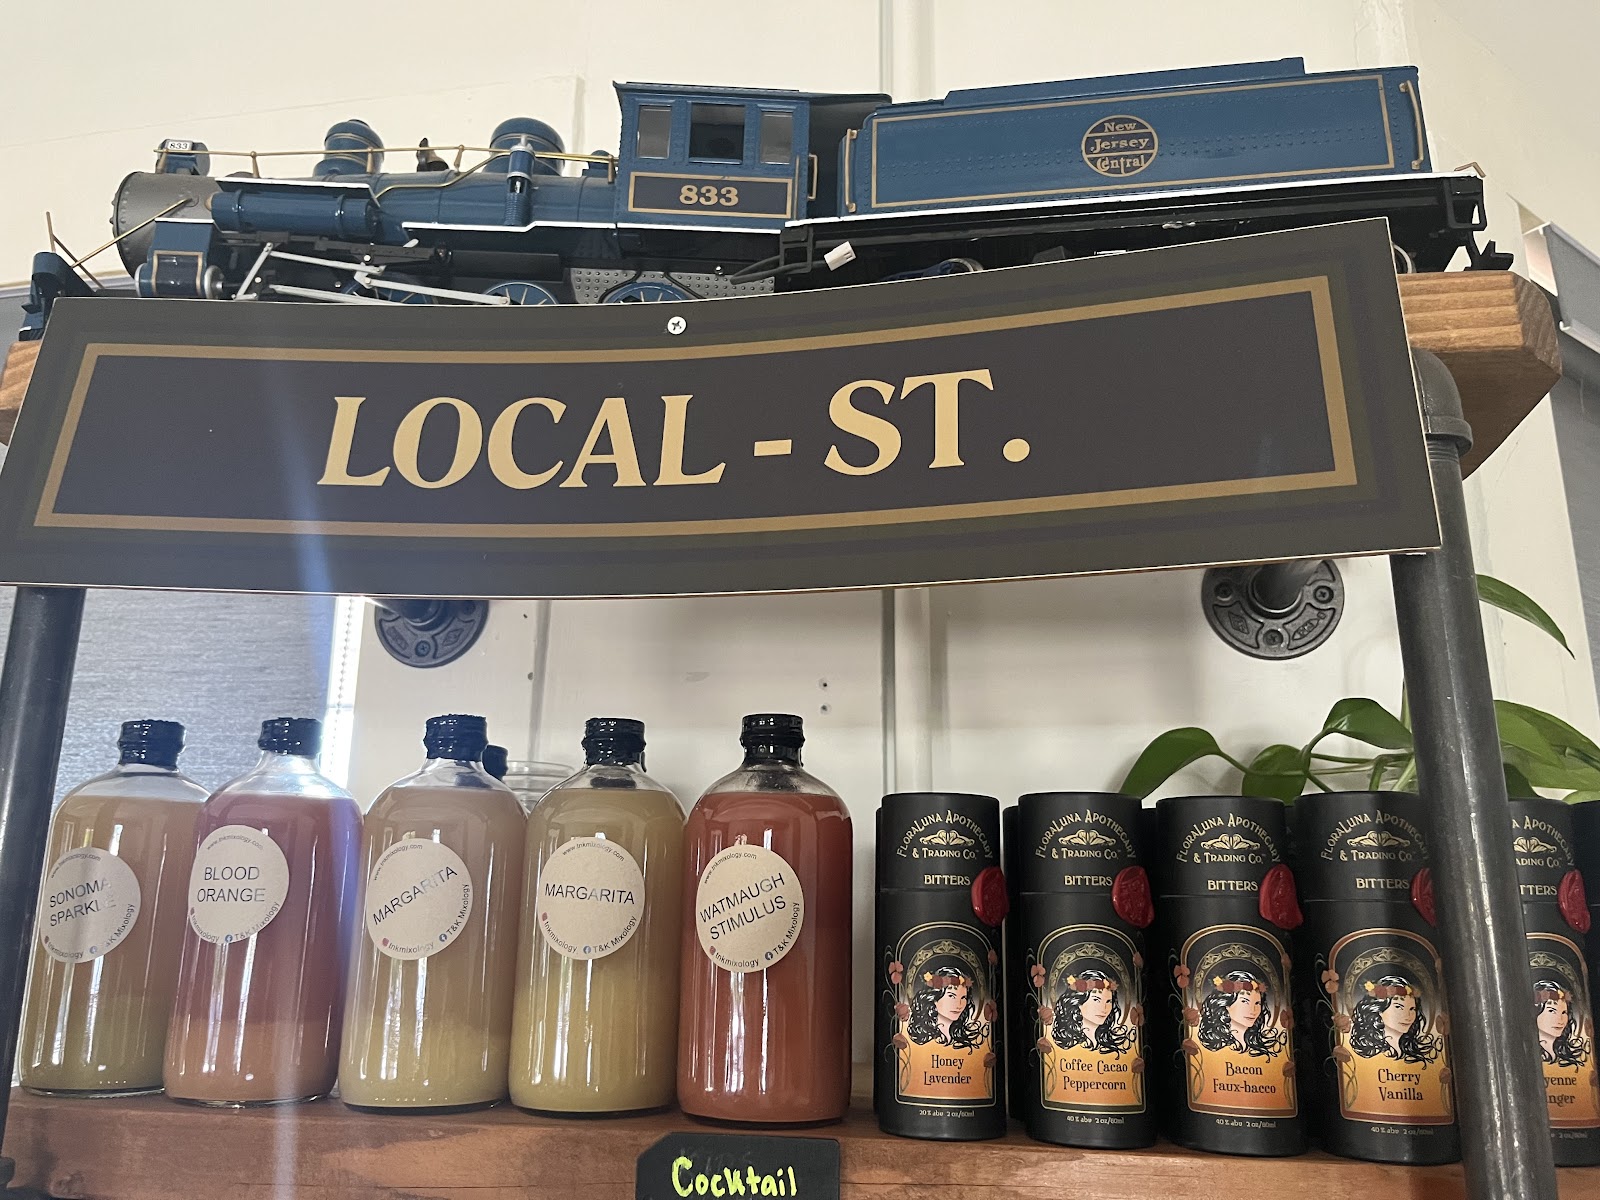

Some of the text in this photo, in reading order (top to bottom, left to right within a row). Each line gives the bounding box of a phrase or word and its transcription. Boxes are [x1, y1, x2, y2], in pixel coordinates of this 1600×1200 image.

[1103, 121, 1137, 133] New
[169, 142, 189, 150] 833
[1090, 137, 1150, 154] Jersey
[1096, 154, 1145, 175] Central
[679, 184, 739, 207] 833
[316, 394, 727, 489] LOCAL
[823, 368, 1031, 477] ST.
[945, 809, 994, 859] APOTHECARY
[1084, 809, 1137, 859] APOTHECARY
[1227, 812, 1281, 863] APOTHECARY
[912, 847, 920, 859] &
[922, 847, 961, 859] TRADING
[1051, 847, 1059, 859] &
[1061, 847, 1102, 859] TRADING
[1193, 852, 1201, 864] &
[1203, 852, 1246, 864] TRADING
[1339, 849, 1348, 862] &
[1350, 849, 1396, 862] TRADING
[1515, 858, 1545, 867] DING
[204, 866, 260, 880] BLOOD
[923, 874, 971, 886] BITTERS
[1064, 875, 1113, 887] BITTERS
[1207, 879, 1259, 891] BITTERS
[1355, 877, 1410, 890] BITTERS
[1519, 884, 1557, 896] TTERS
[49, 877, 113, 908] SONOMA
[196, 887, 267, 903] ORANGE
[372, 866, 458, 926] MARGARITA
[544, 883, 635, 905] MARGARITA
[699, 872, 785, 923] WATMAUGH
[50, 898, 117, 927] SPARKLE
[251, 901, 281, 934] Mixology
[445, 883, 470, 936] T&K Mixology
[709, 895, 786, 940] STIMULUS
[114, 903, 136, 938] Mixology
[772, 902, 800, 955] T&K Mixology
[592, 915, 637, 953] T&K Mixology
[931, 1054, 965, 1070] Honey
[1059, 1058, 1128, 1075] Coffee Cacao
[1225, 1061, 1263, 1077] Bacon
[923, 1071, 972, 1086] Lavender
[1063, 1075, 1127, 1092] Peppercorn
[1377, 1068, 1421, 1086] Cherry
[1543, 1076, 1577, 1089] yenne
[1212, 1078, 1276, 1094] Faux-bacco
[1378, 1086, 1424, 1102] Vanilla
[1547, 1093, 1576, 1107] nger
[671, 1155, 798, 1199] Cocktail
